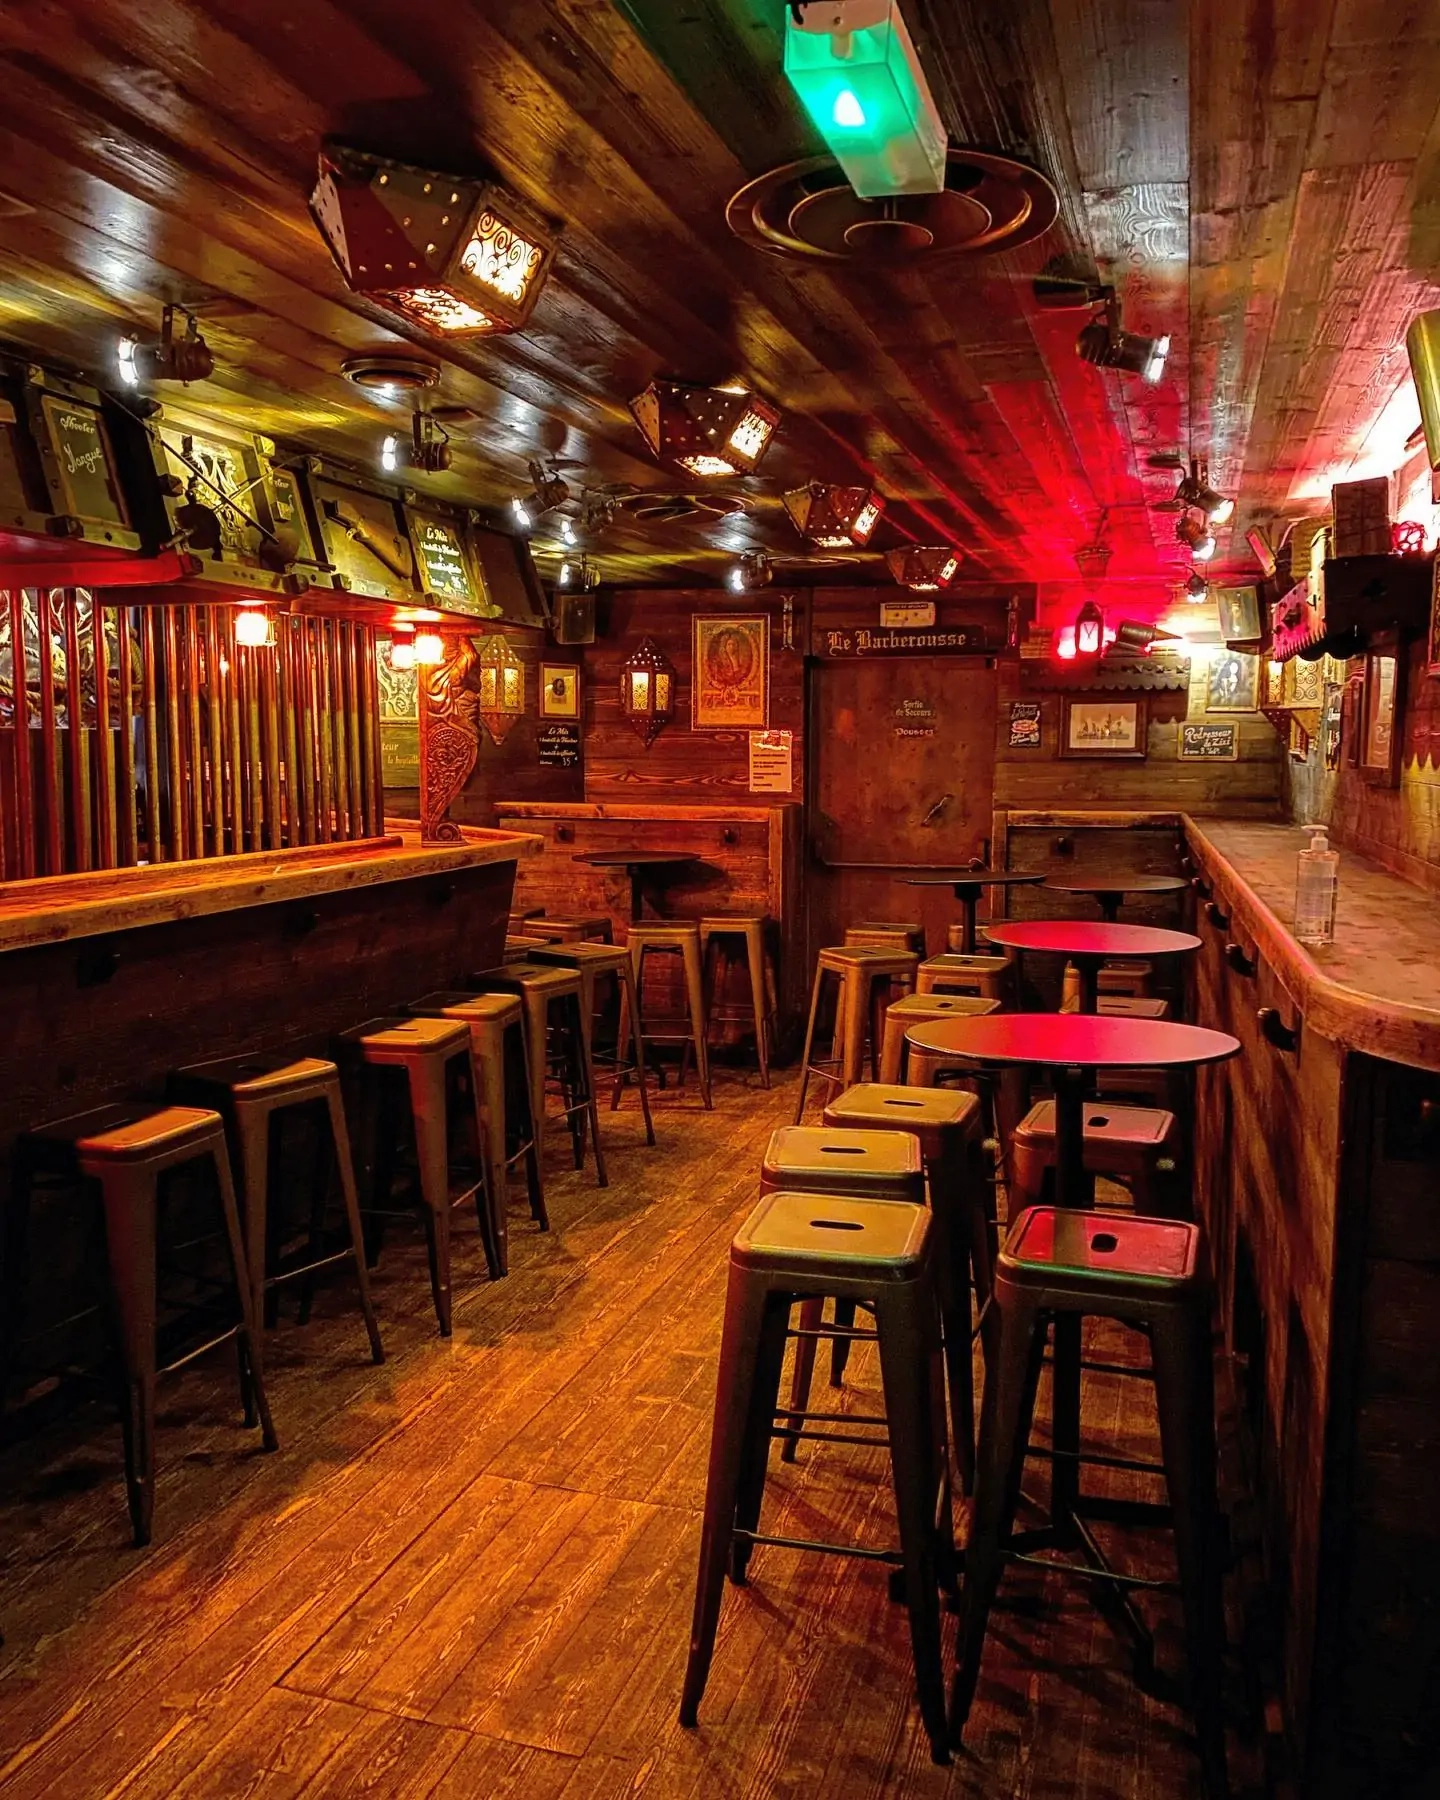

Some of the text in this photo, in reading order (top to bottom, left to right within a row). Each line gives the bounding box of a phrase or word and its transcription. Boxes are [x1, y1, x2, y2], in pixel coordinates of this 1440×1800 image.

[60, 416, 96, 434] Shooter
[827, 630, 967, 656] Le Barberousse
